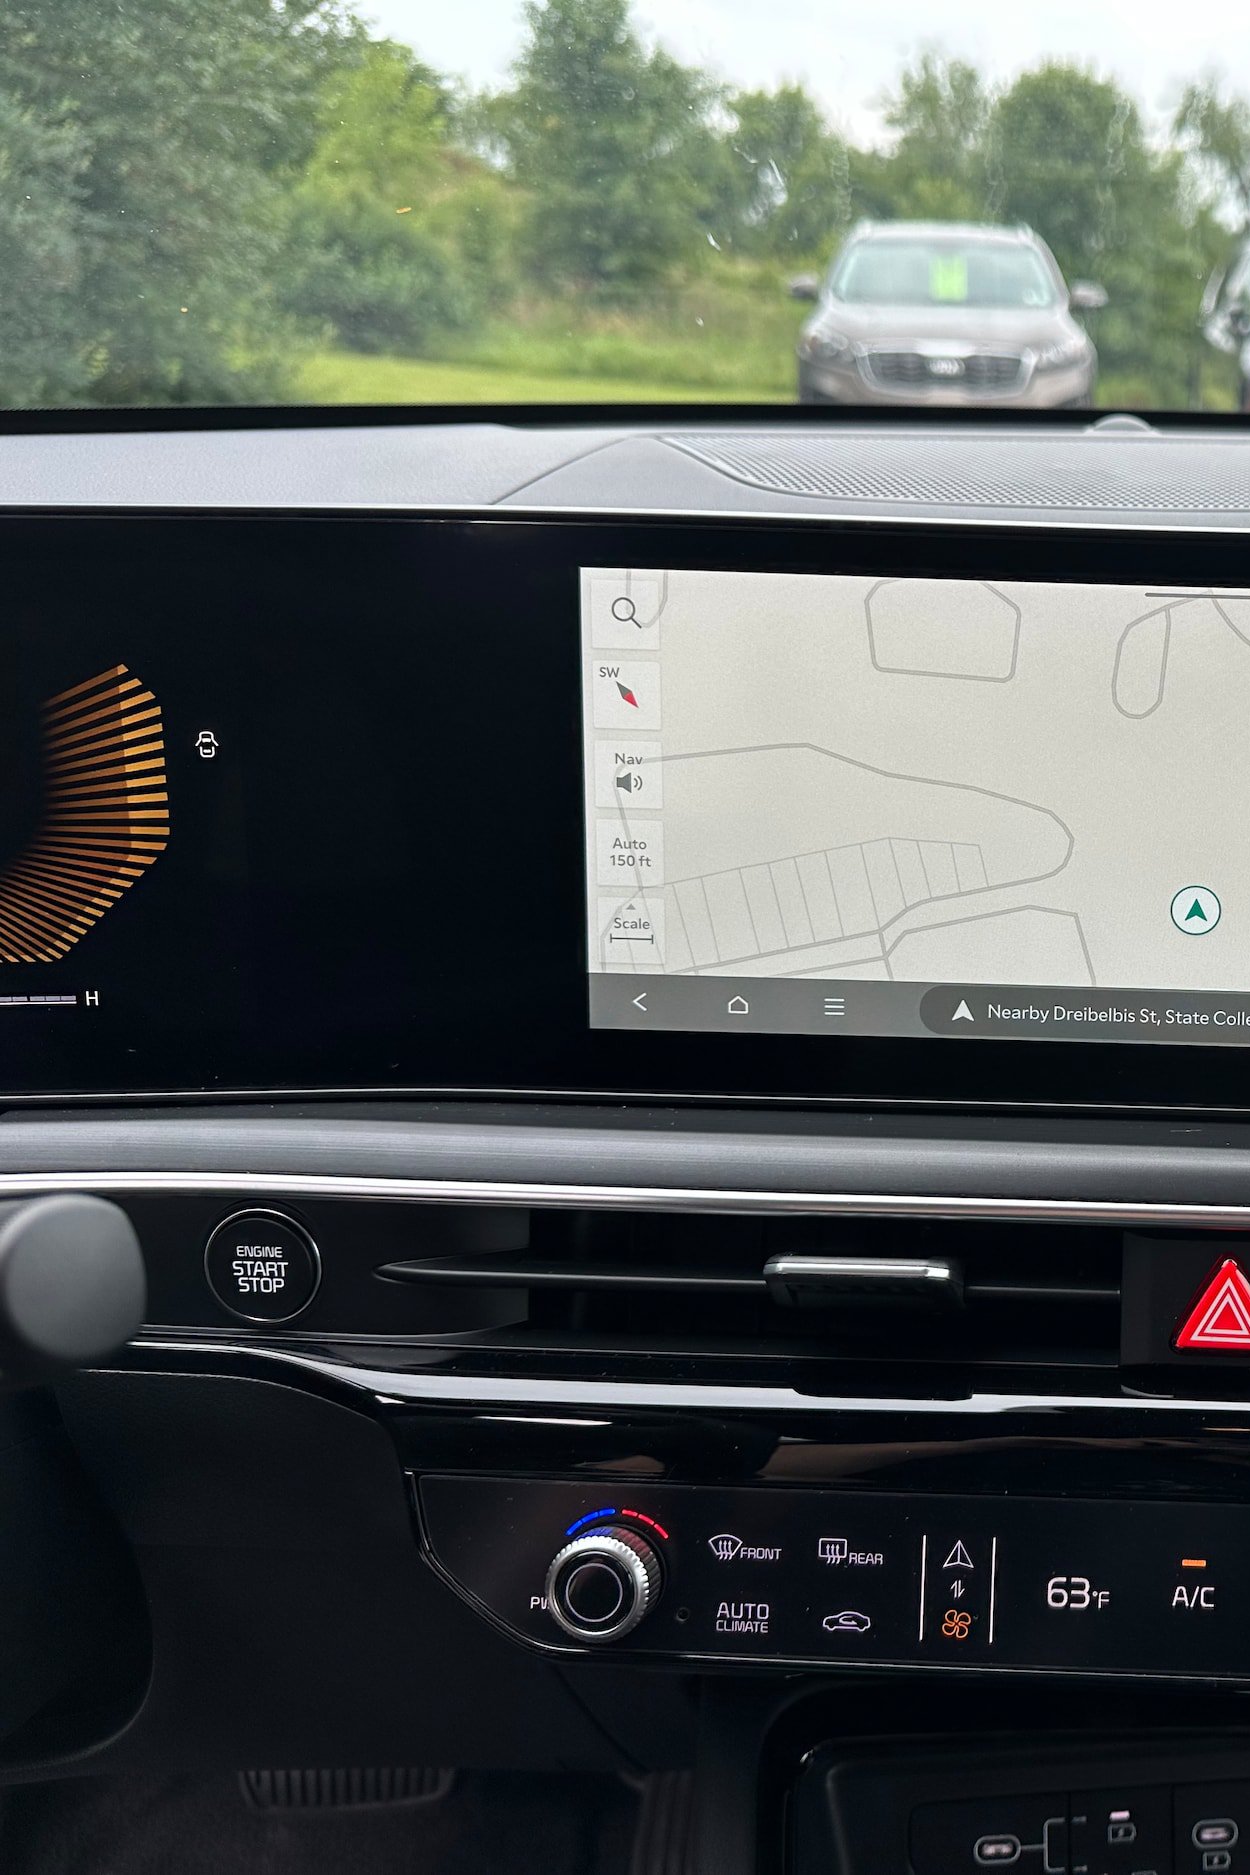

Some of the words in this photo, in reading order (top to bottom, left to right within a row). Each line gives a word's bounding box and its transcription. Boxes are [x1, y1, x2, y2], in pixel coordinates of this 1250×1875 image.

[599, 666, 620, 678] SW
[614, 752, 643, 765] Nav
[612, 837, 647, 850] Auto
[609, 854, 635, 867] 150
[638, 855, 652, 868] ft
[613, 917, 651, 930] Scale
[85, 990, 99, 1006] H
[987, 1003, 1050, 1023] Nearby
[1053, 1005, 1136, 1024] Dreibelbis
[1139, 1008, 1162, 1027] St,
[1165, 1008, 1210, 1026] State
[236, 1245, 283, 1258] ENGINE
[232, 1260, 289, 1278] START
[238, 1276, 285, 1293] STOP
[740, 1546, 783, 1561] FRONT
[848, 1552, 884, 1566] REAR
[1171, 1585, 1216, 1609] A/C
[716, 1602, 770, 1620] AUTO
[715, 1619, 769, 1634] CLIMATE
